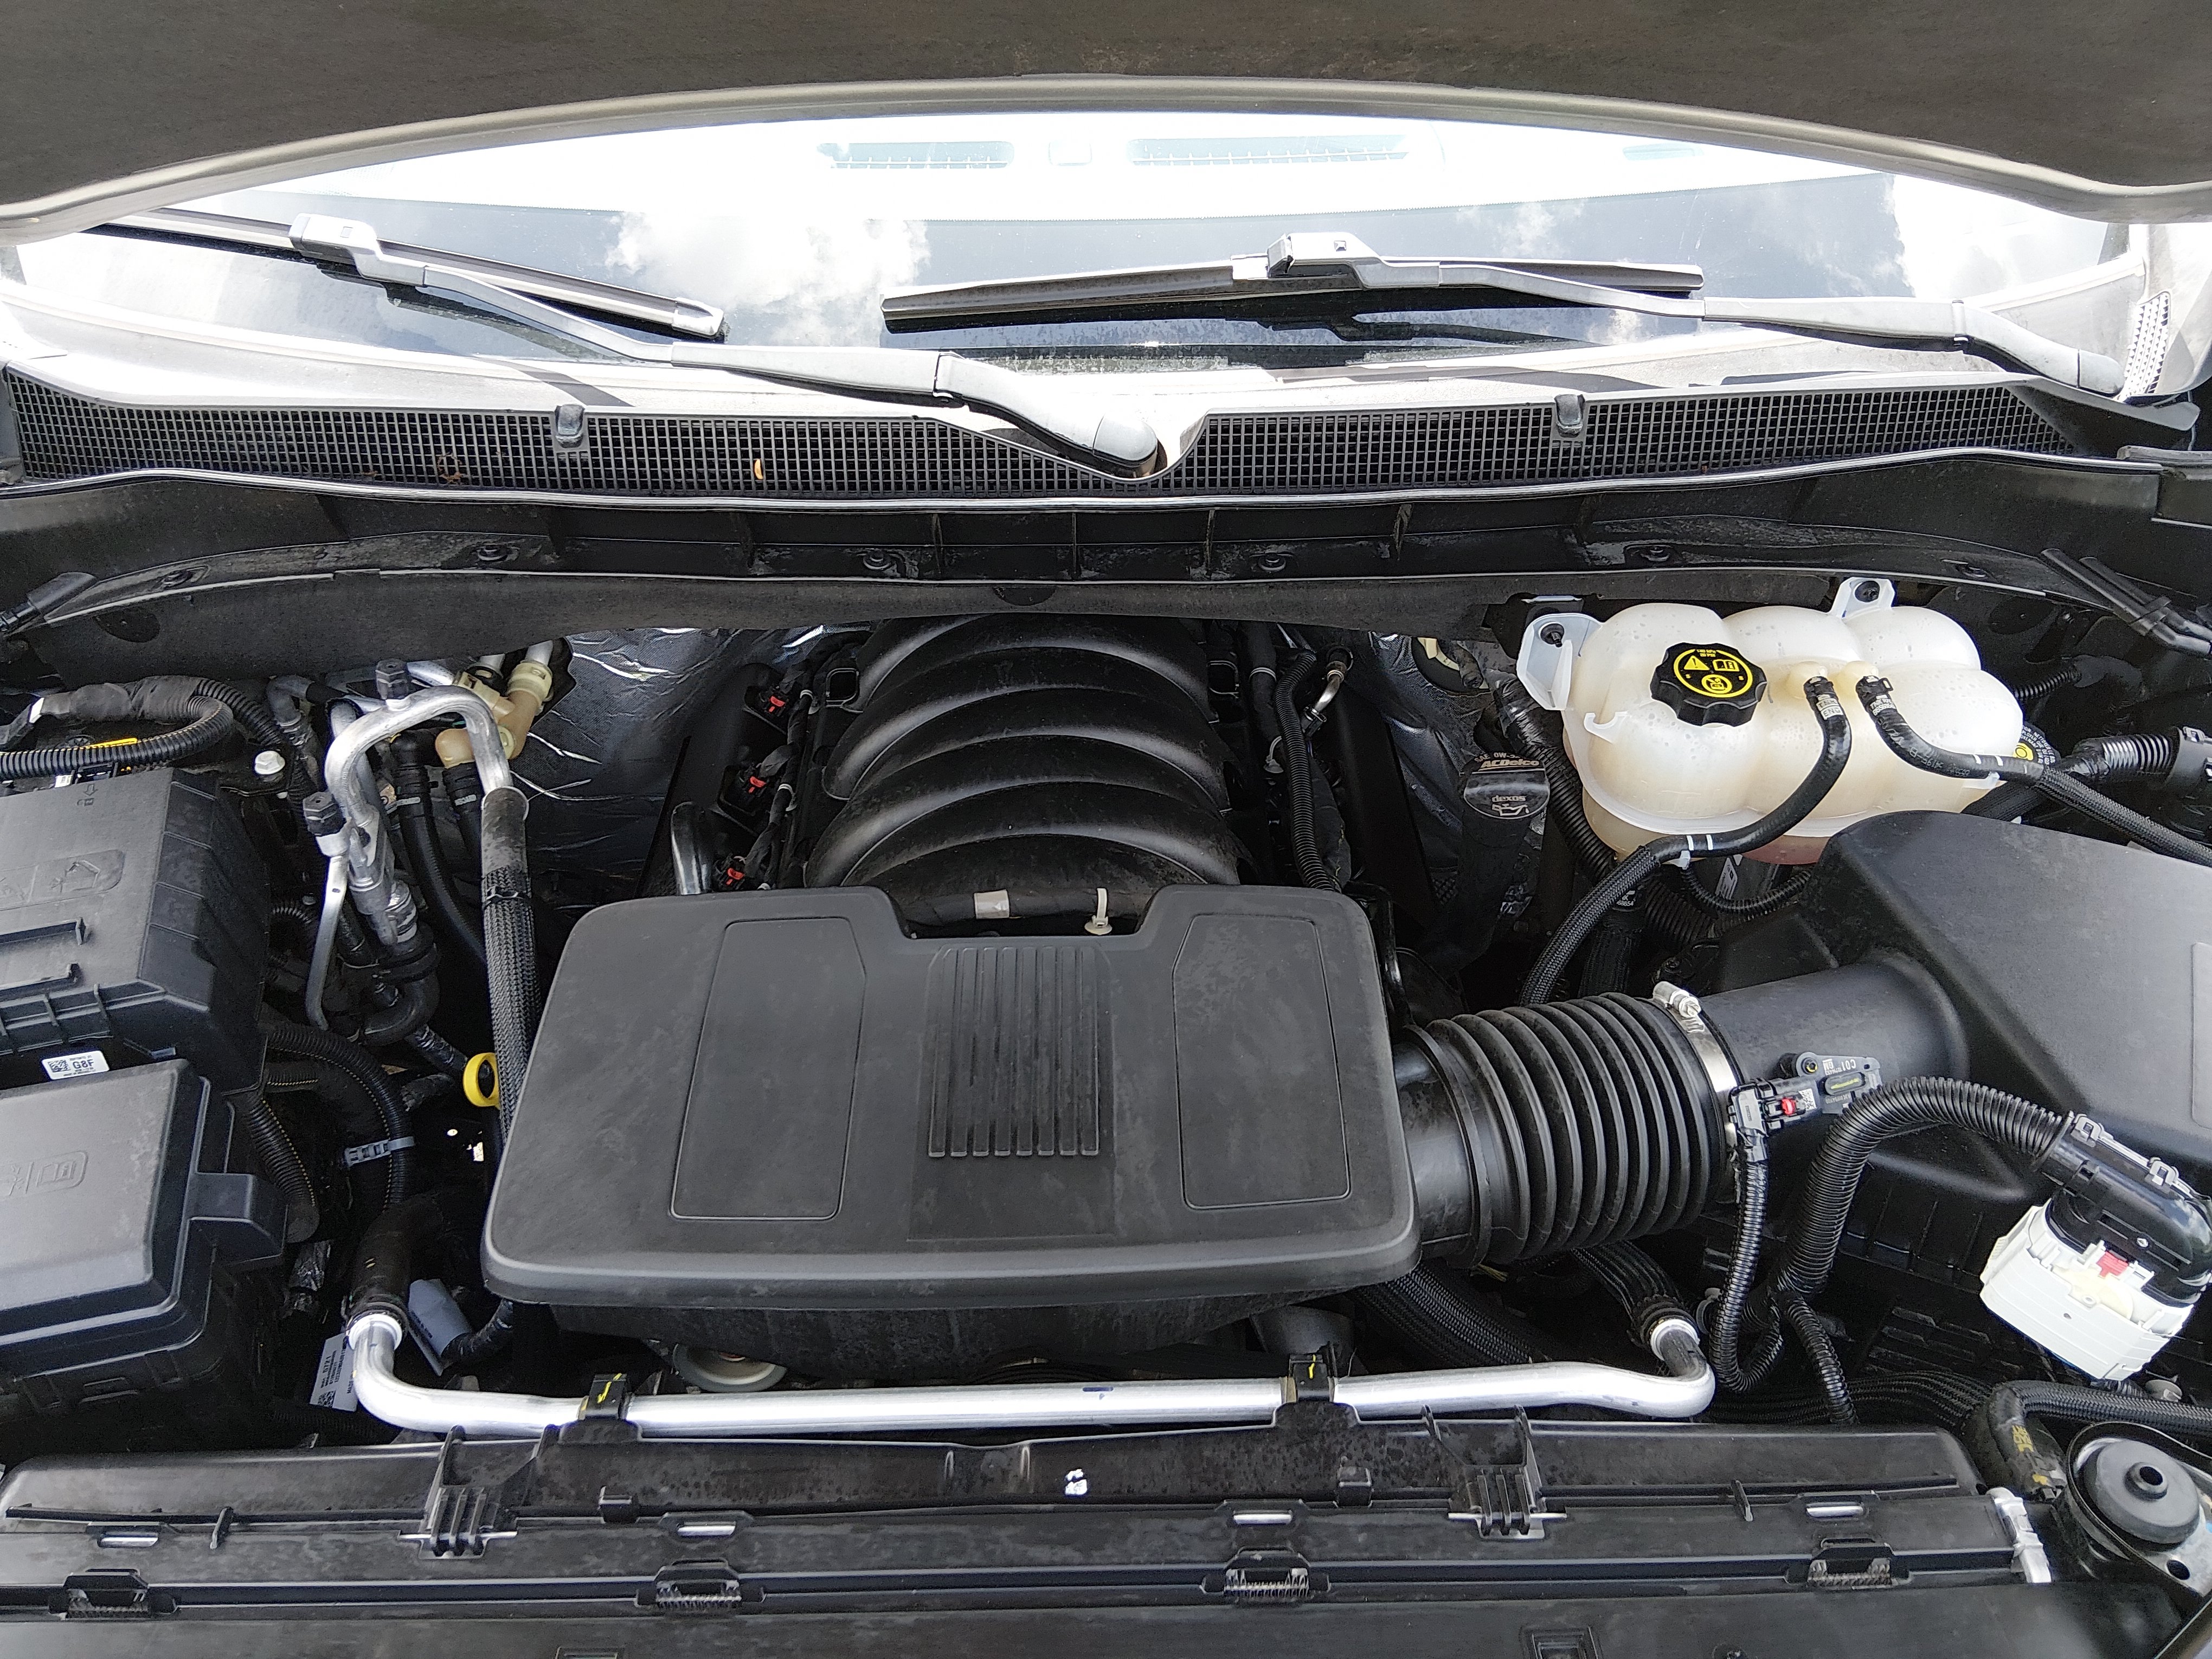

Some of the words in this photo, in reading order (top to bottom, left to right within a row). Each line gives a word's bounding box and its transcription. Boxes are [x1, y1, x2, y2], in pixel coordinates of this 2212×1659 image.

[1823, 707, 1841, 717] ENG
[1474, 753, 1491, 763] SAE
[1480, 758, 1540, 768] ACDelco
[72, 1059, 94, 1069] G8F
